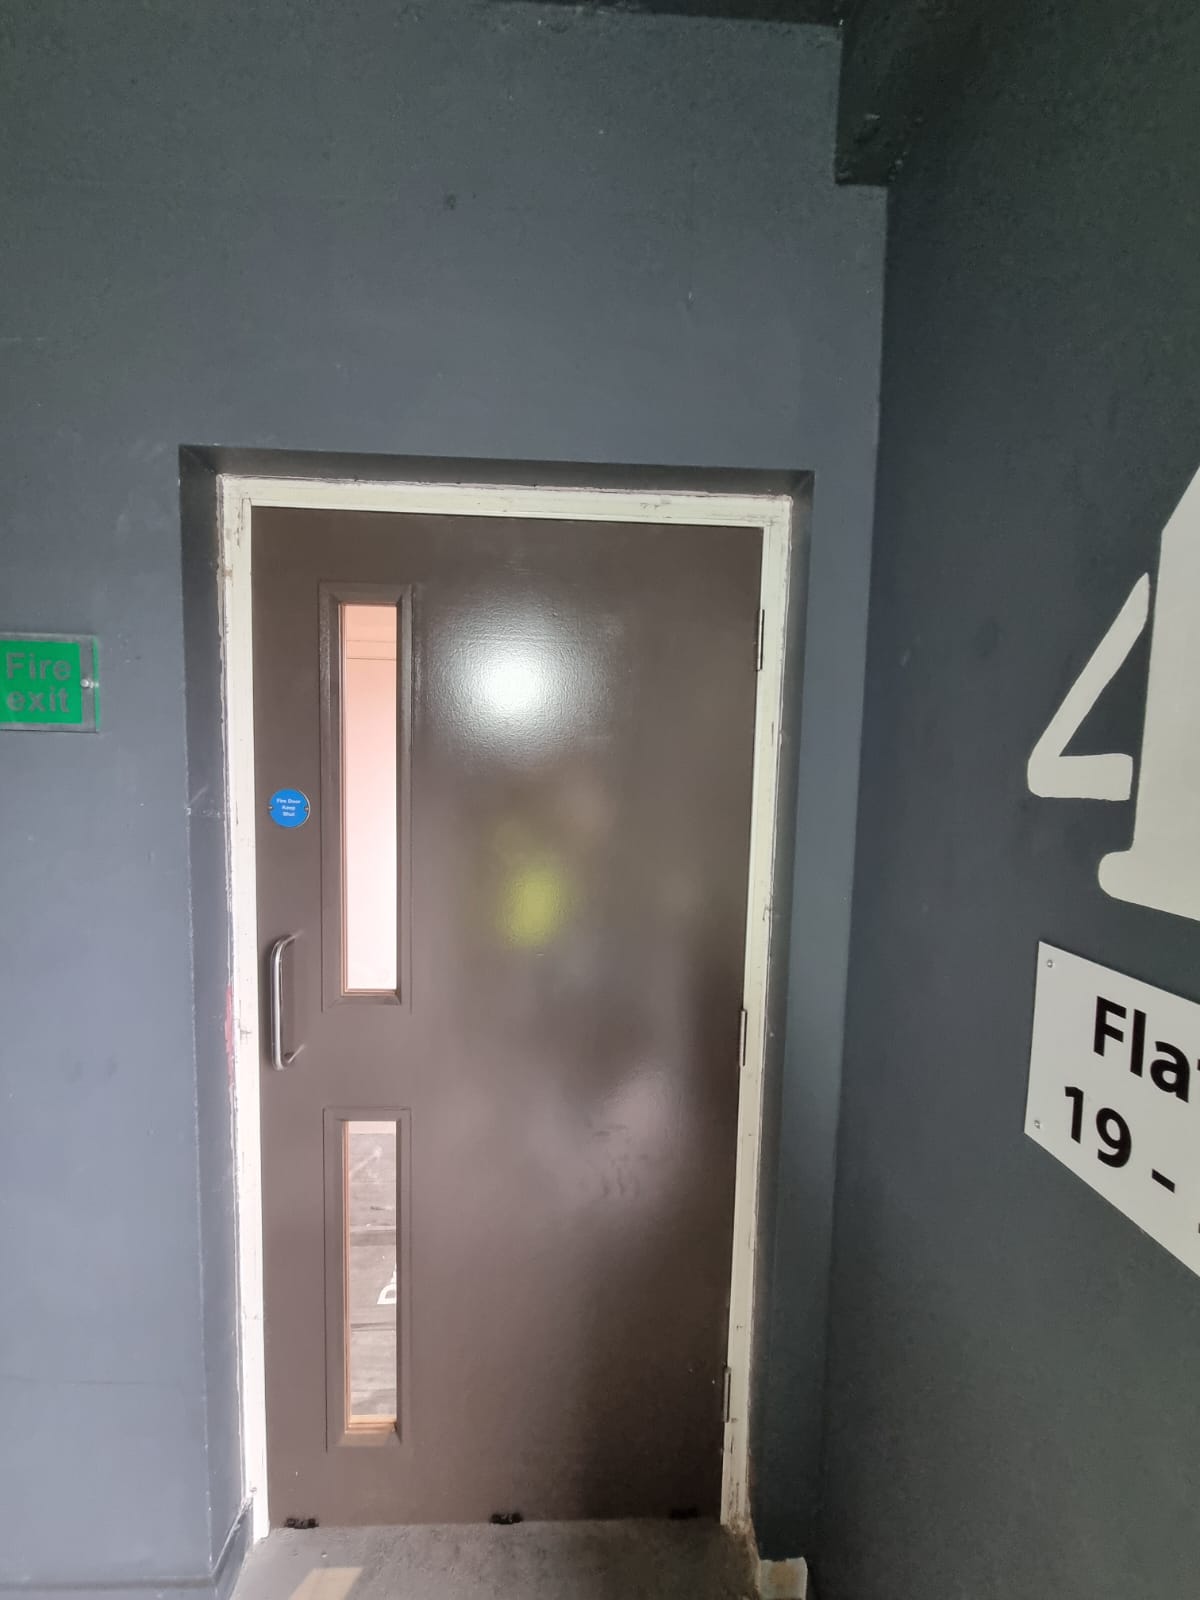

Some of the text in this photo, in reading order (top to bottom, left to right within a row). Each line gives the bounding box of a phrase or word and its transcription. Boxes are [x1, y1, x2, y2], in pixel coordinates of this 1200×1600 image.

[6, 652, 71, 681] Fire
[7, 687, 70, 713] exit
[1093, 996, 1200, 1103] Fla
[1064, 1086, 1132, 1168] 19
